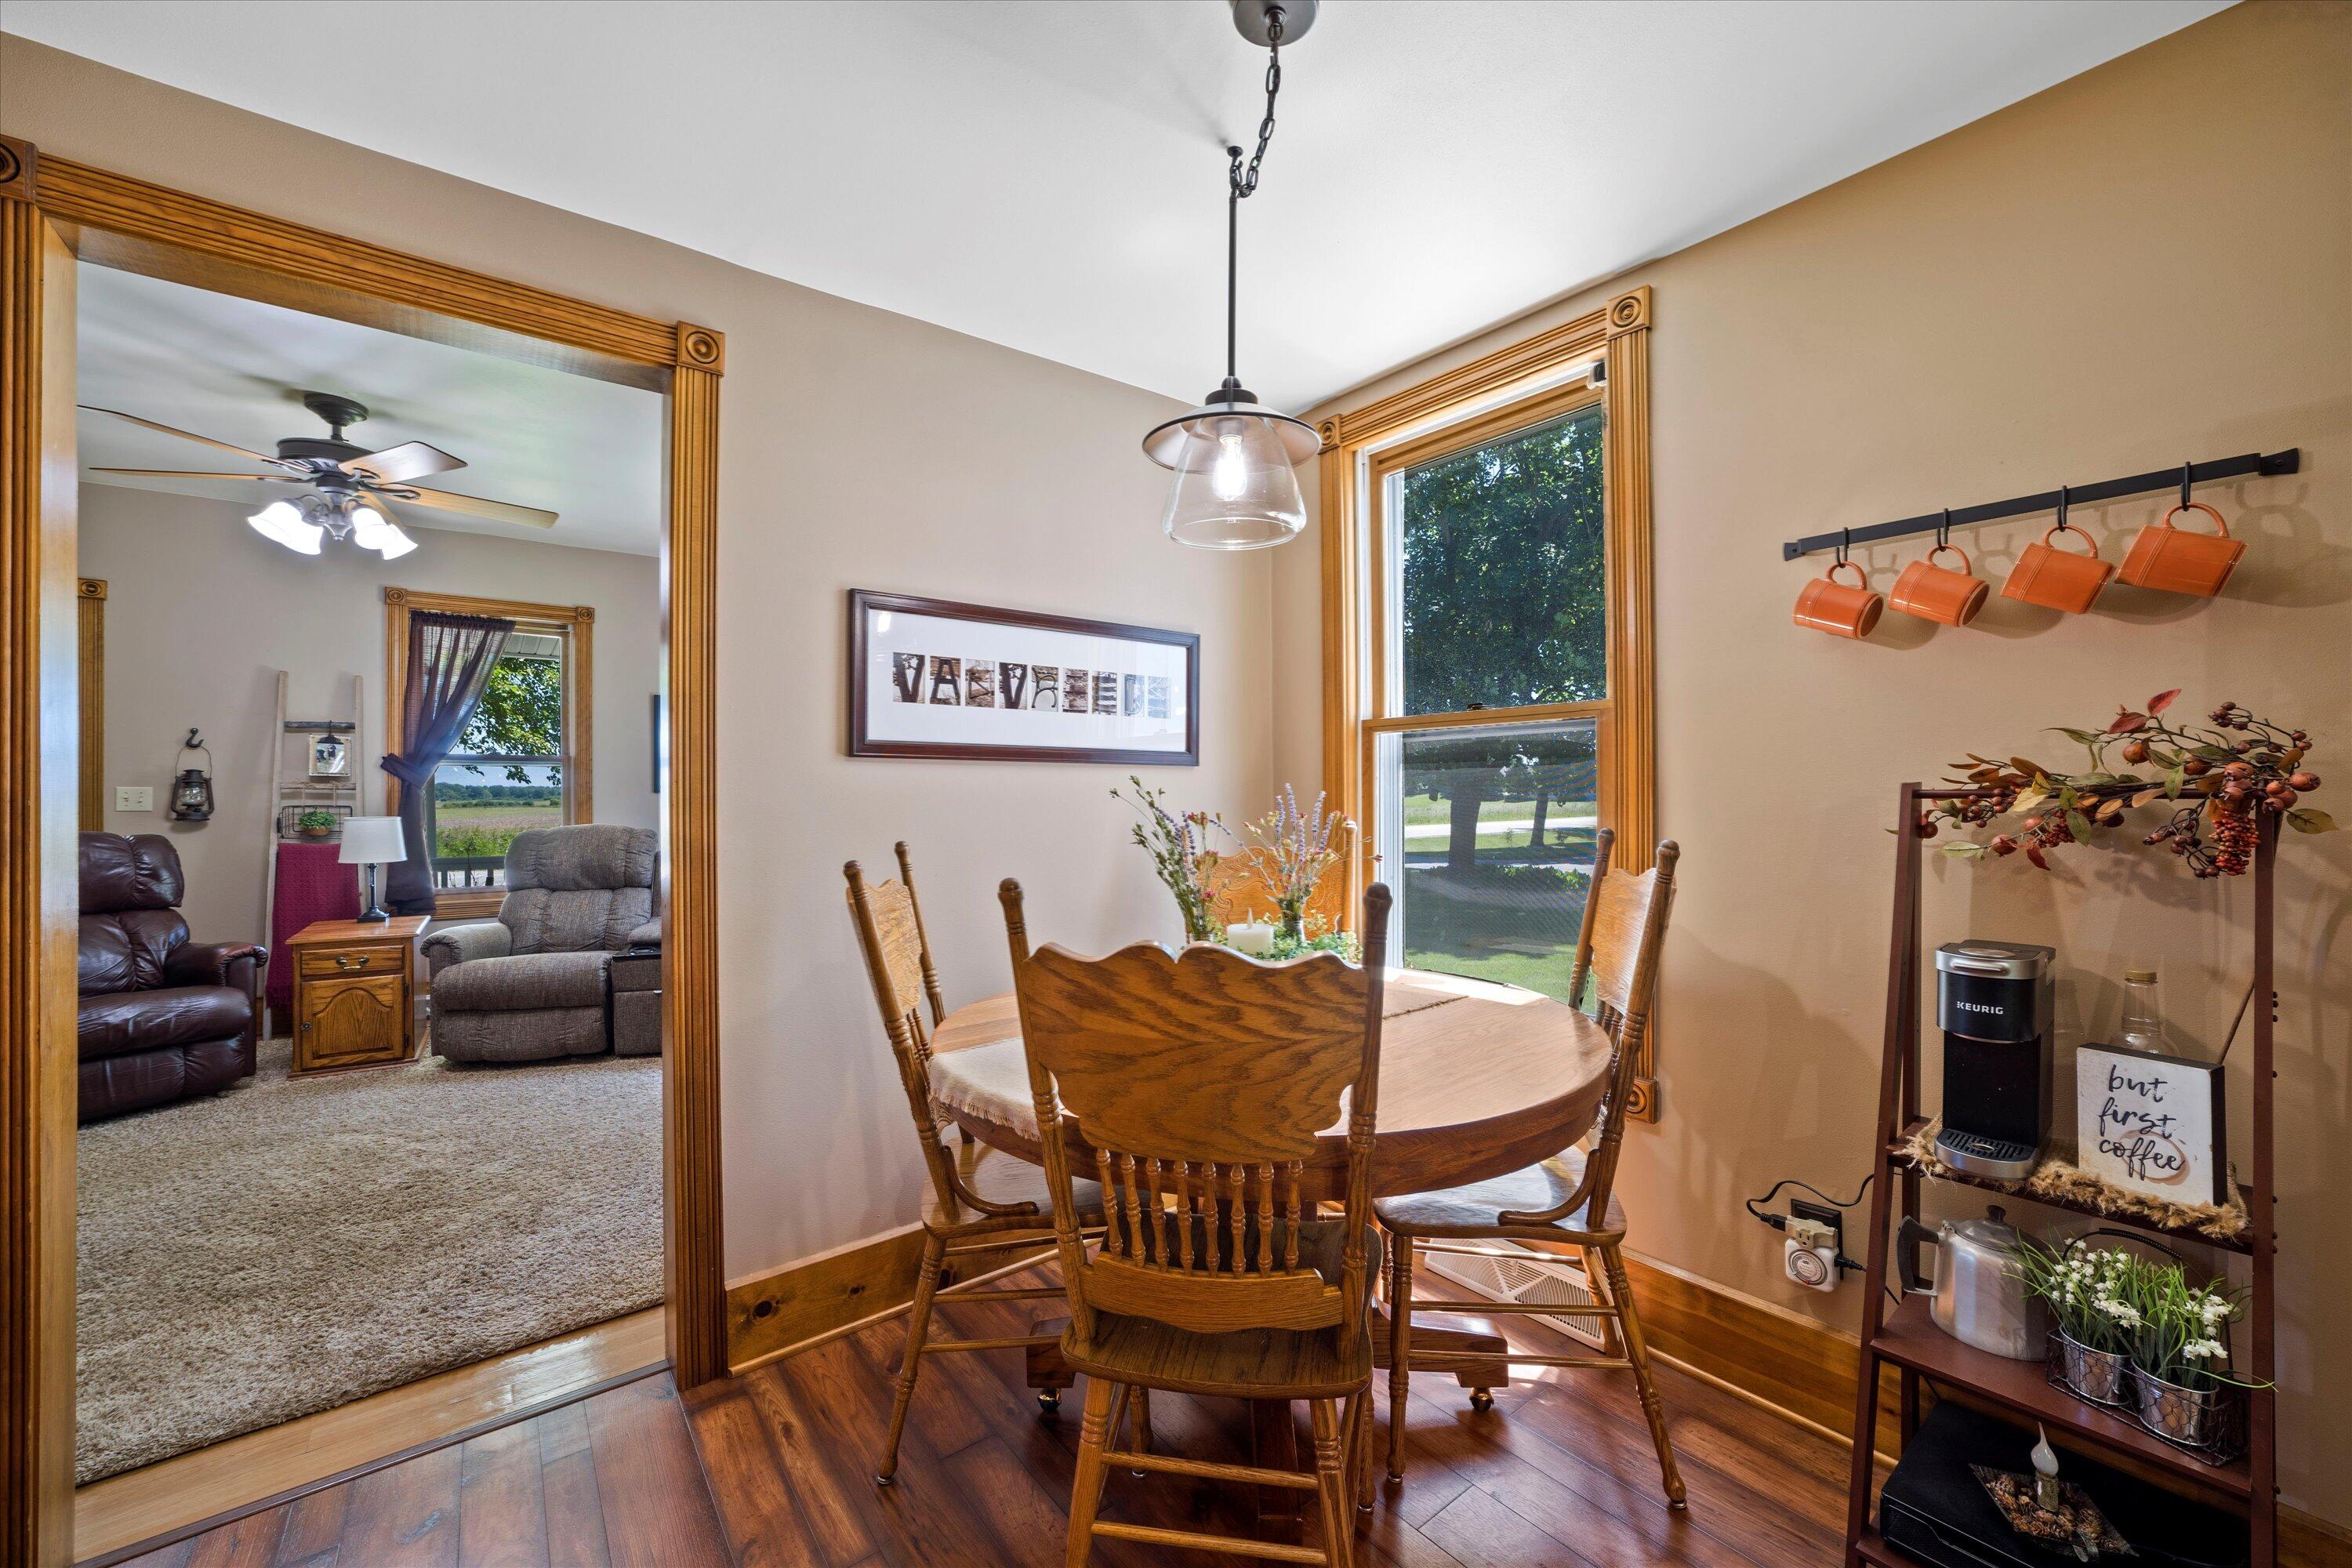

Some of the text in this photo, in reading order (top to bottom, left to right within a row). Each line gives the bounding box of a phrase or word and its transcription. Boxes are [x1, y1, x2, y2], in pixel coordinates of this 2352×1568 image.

[1957, 1001, 2004, 1014] KEURIG
[2109, 1064, 2168, 1103] but
[2099, 1097, 2176, 1139] first
[2100, 1137, 2186, 1181] coffee
